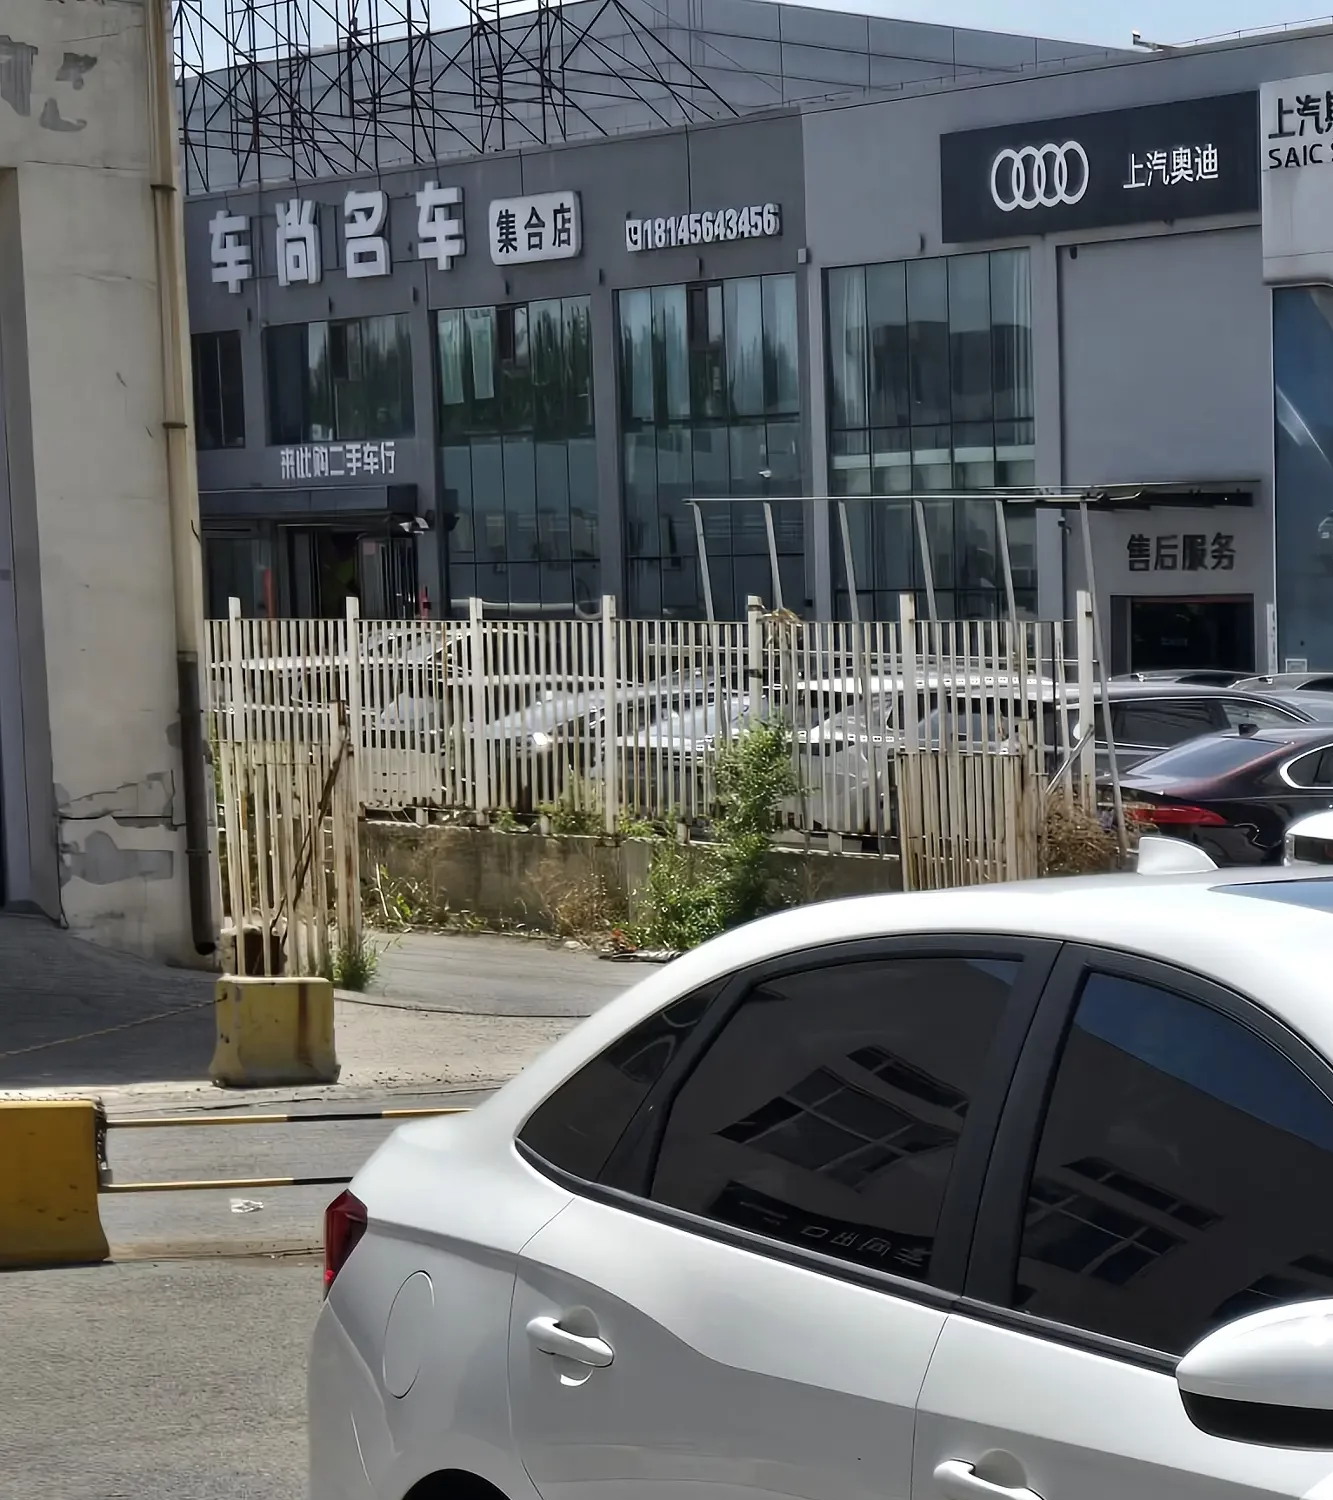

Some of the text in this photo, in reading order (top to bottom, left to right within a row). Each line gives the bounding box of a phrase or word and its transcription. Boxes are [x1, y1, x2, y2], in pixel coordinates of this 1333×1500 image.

[1123, 143, 1219, 189] 上汽奥迪
[1268, 142, 1323, 169] SAIC
[209, 180, 573, 294] 车尚名车 集合店
[641, 202, 773, 250] 18145643456
[1126, 532, 1237, 572] 售后服务
